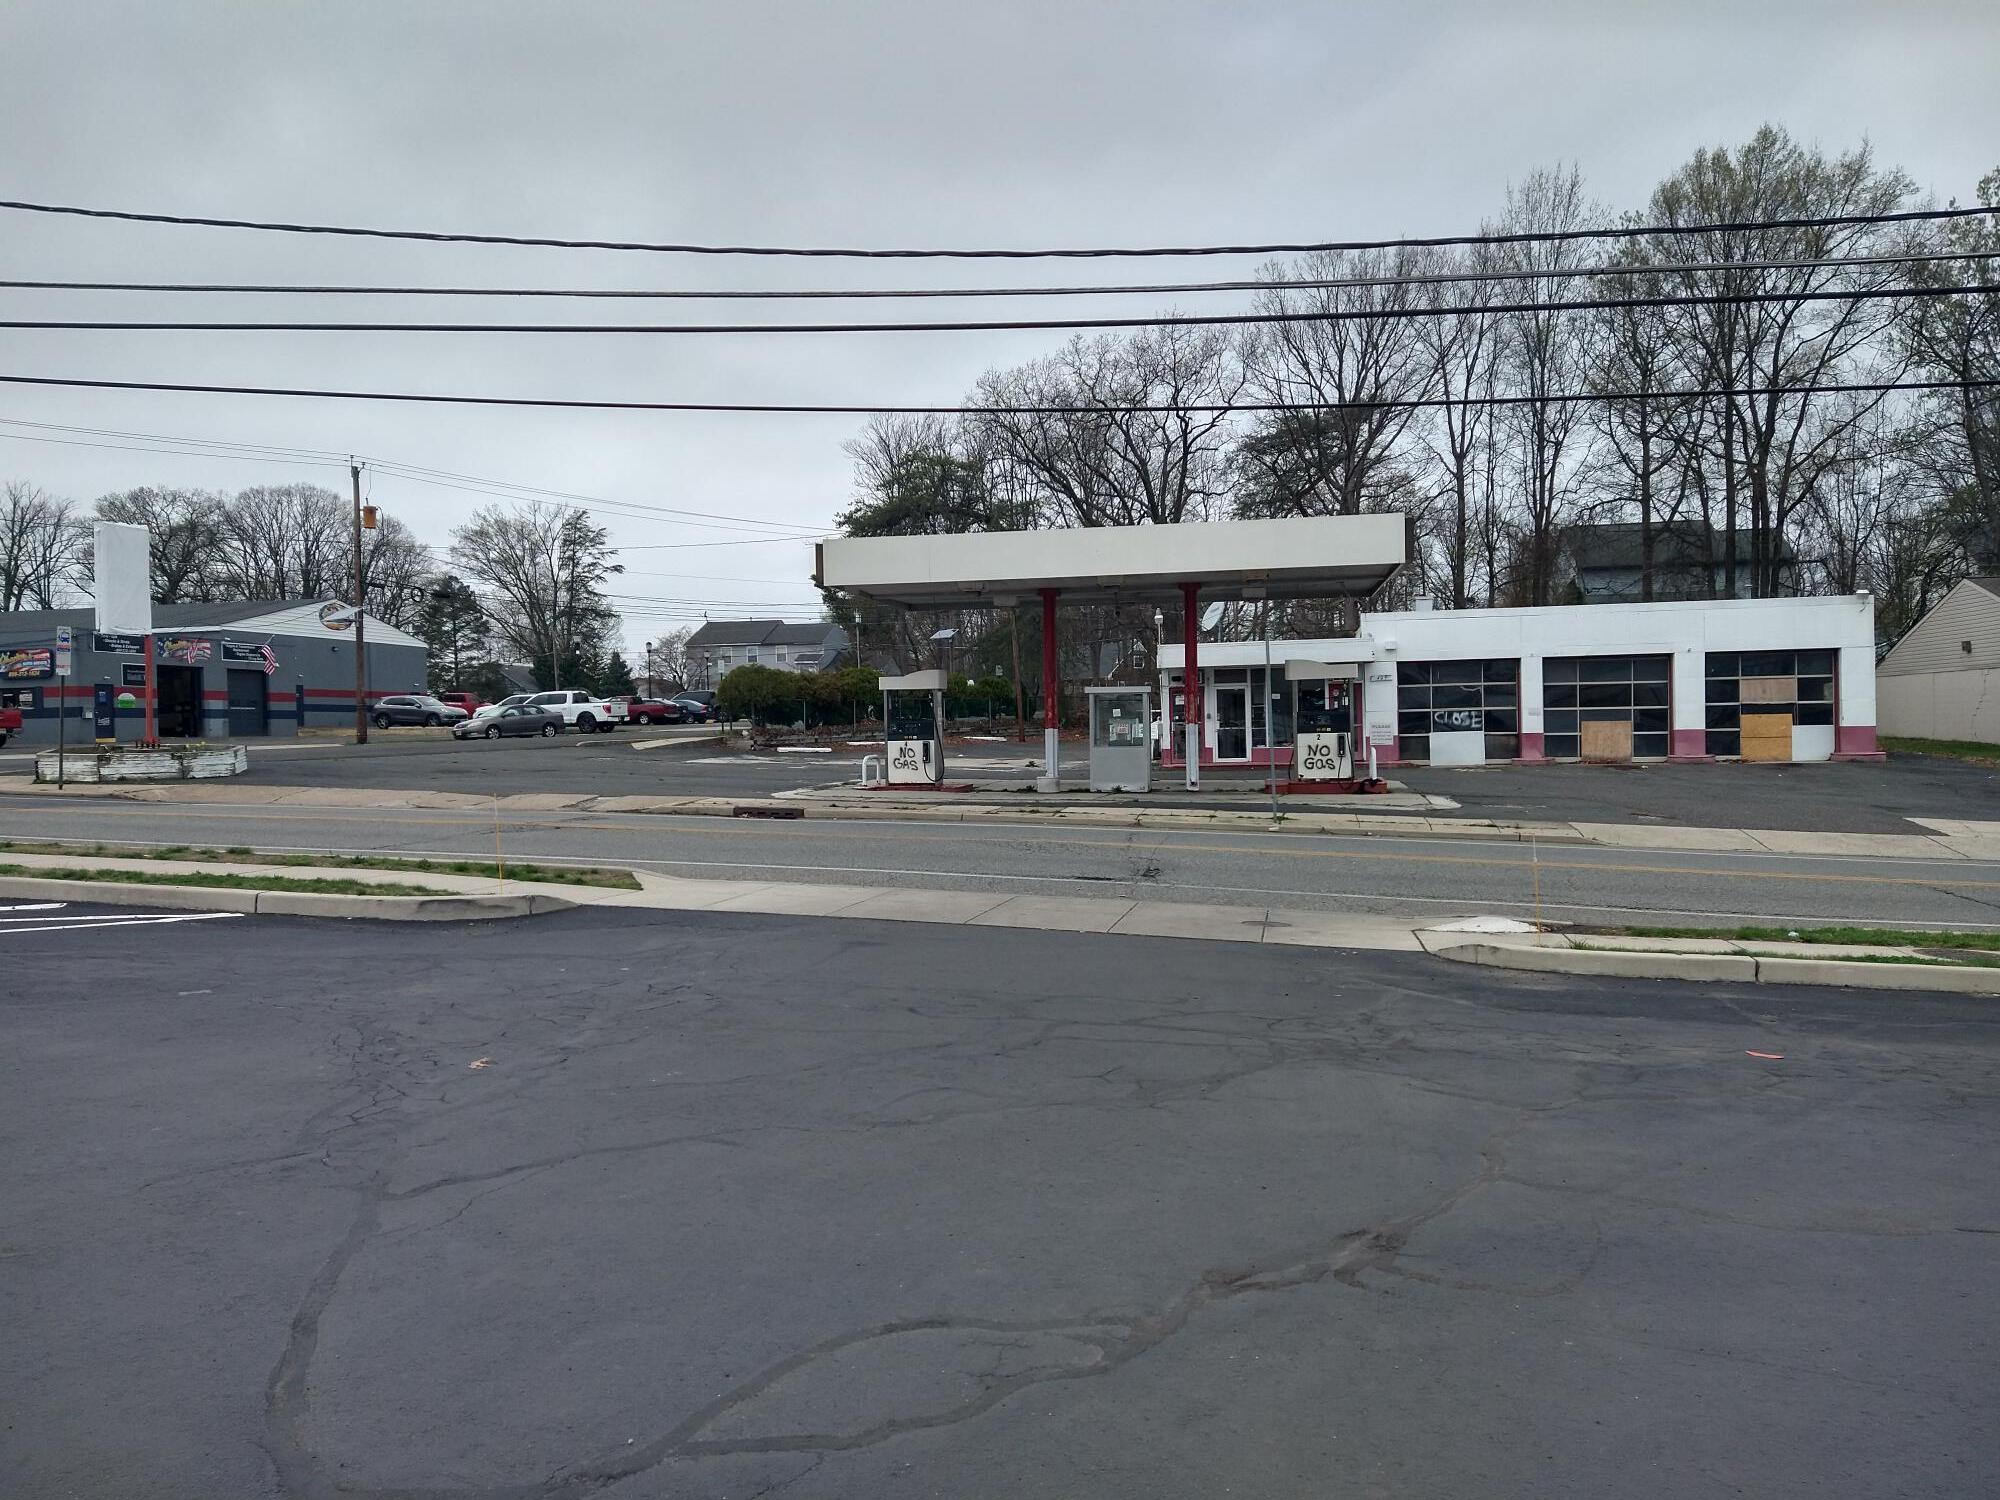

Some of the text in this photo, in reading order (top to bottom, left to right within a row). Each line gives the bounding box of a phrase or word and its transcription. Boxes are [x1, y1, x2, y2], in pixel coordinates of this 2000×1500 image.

[900, 747, 916, 758] NO
[1308, 744, 1330, 756] NO
[893, 758, 918, 770] GAS
